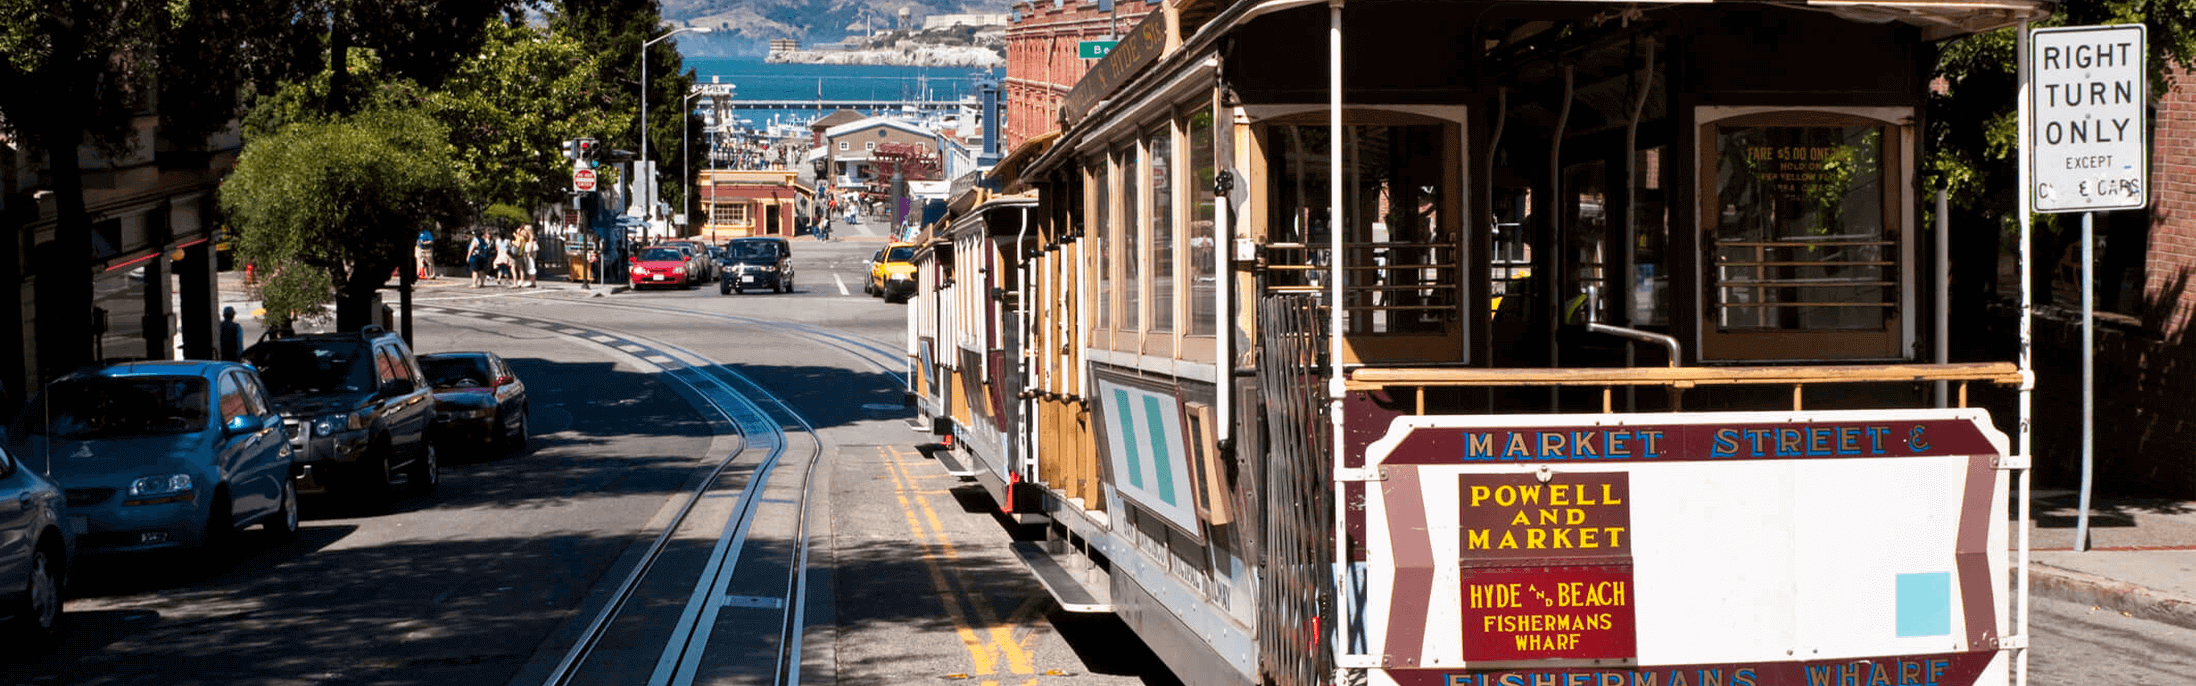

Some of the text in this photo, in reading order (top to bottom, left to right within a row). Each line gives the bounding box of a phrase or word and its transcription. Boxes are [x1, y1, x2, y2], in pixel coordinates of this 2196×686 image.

[1111, 35, 1140, 79] HYDE
[2044, 43, 2131, 70] RIGHT
[2045, 80, 2131, 107] TURN
[2046, 118, 2130, 145] ONLY
[1747, 146, 1773, 160] FARE
[2066, 155, 2113, 170] EXCEPT
[1464, 430, 1664, 460] MARKET
[1711, 426, 1891, 458] STREET
[1471, 484, 1622, 507] POWELL
[1511, 508, 1586, 526] AND
[1468, 527, 1625, 550] MARKET
[1470, 581, 1625, 609] HYDE AND BEACH
[1484, 613, 1612, 633] FISHERMANS
[1515, 633, 1581, 651] WHARF
[1443, 659, 1949, 686] FISHERMANS WHARF
